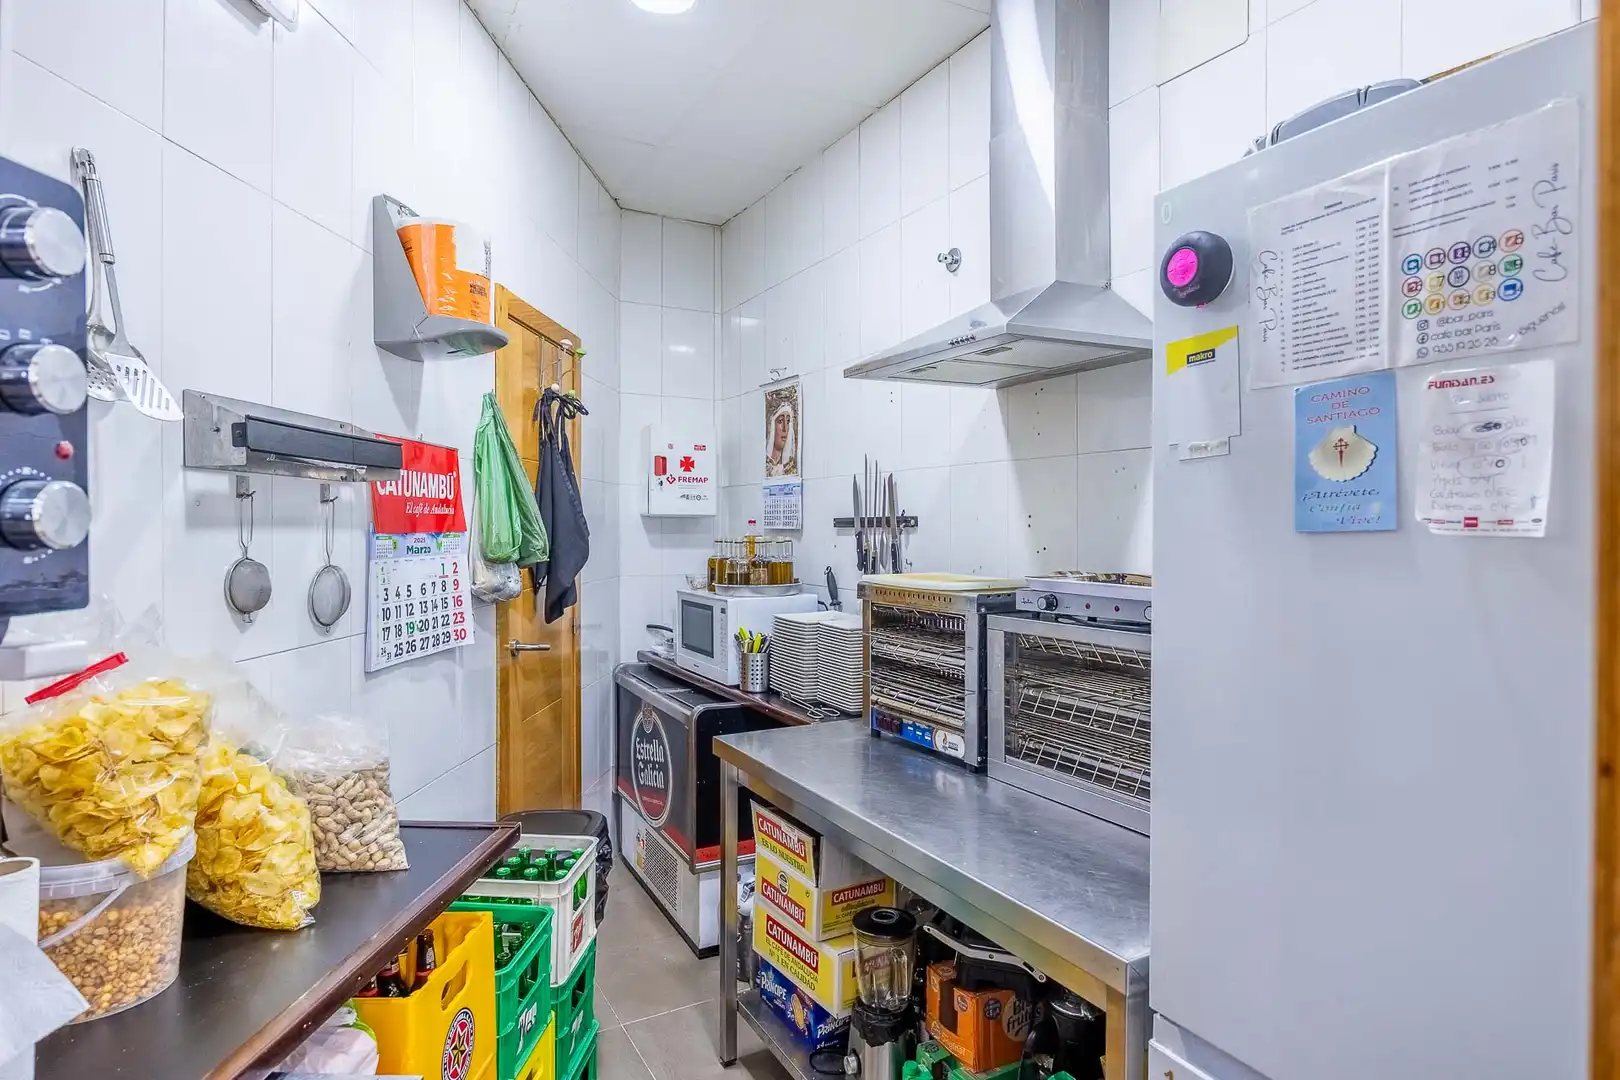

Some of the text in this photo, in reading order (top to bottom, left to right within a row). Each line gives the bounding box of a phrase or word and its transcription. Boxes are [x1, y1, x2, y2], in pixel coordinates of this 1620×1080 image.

[1188, 351, 1213, 363] makro
[1311, 386, 1370, 403] CAMINO
[1331, 400, 1350, 410] DE
[1307, 407, 1381, 425] SANTIAGO
[678, 476, 709, 484] FREMAP
[423, 502, 430, 514] de
[406, 545, 431, 555] Marzo
[453, 561, 459, 574] 2
[383, 578, 459, 602] 3 4 5 6 7 8 9
[382, 595, 463, 622] 10 11 12 13 14 15 16
[382, 612, 465, 641] 17 18 19 20 21 22 23
[394, 642, 404, 658] 25
[405, 639, 417, 654] 26
[420, 636, 430, 650] 27
[431, 633, 440, 648] 28
[441, 630, 451, 645] 29
[453, 628, 467, 641] 30
[635, 737, 665, 763] Estrella
[638, 761, 665, 789] Galicia
[779, 848, 806, 874] NUESTRO
[781, 957, 790, 970] EN
[789, 966, 816, 991] CALIDAD
